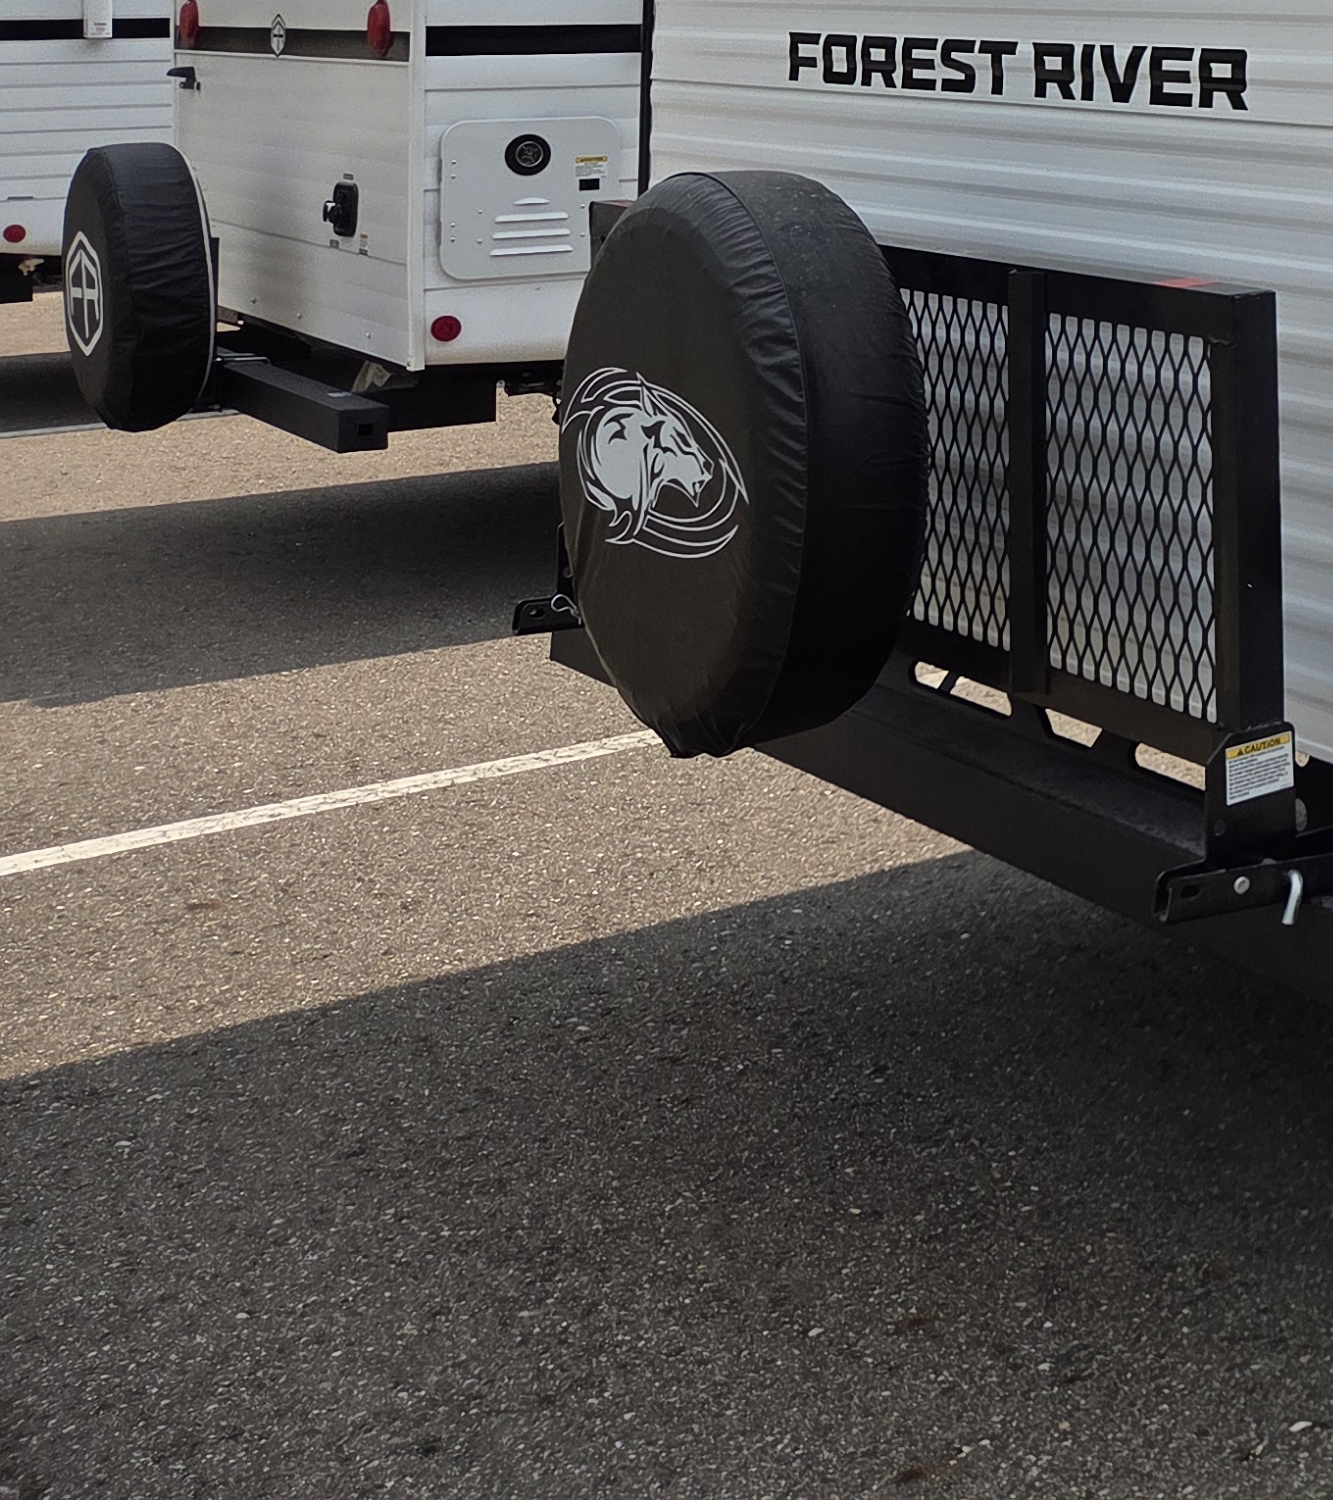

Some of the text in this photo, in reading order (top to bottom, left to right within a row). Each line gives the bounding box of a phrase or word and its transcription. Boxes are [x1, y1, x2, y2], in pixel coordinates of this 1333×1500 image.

[788, 31, 1250, 111] FOREST RIVER
[1243, 737, 1282, 754] CAUTION
